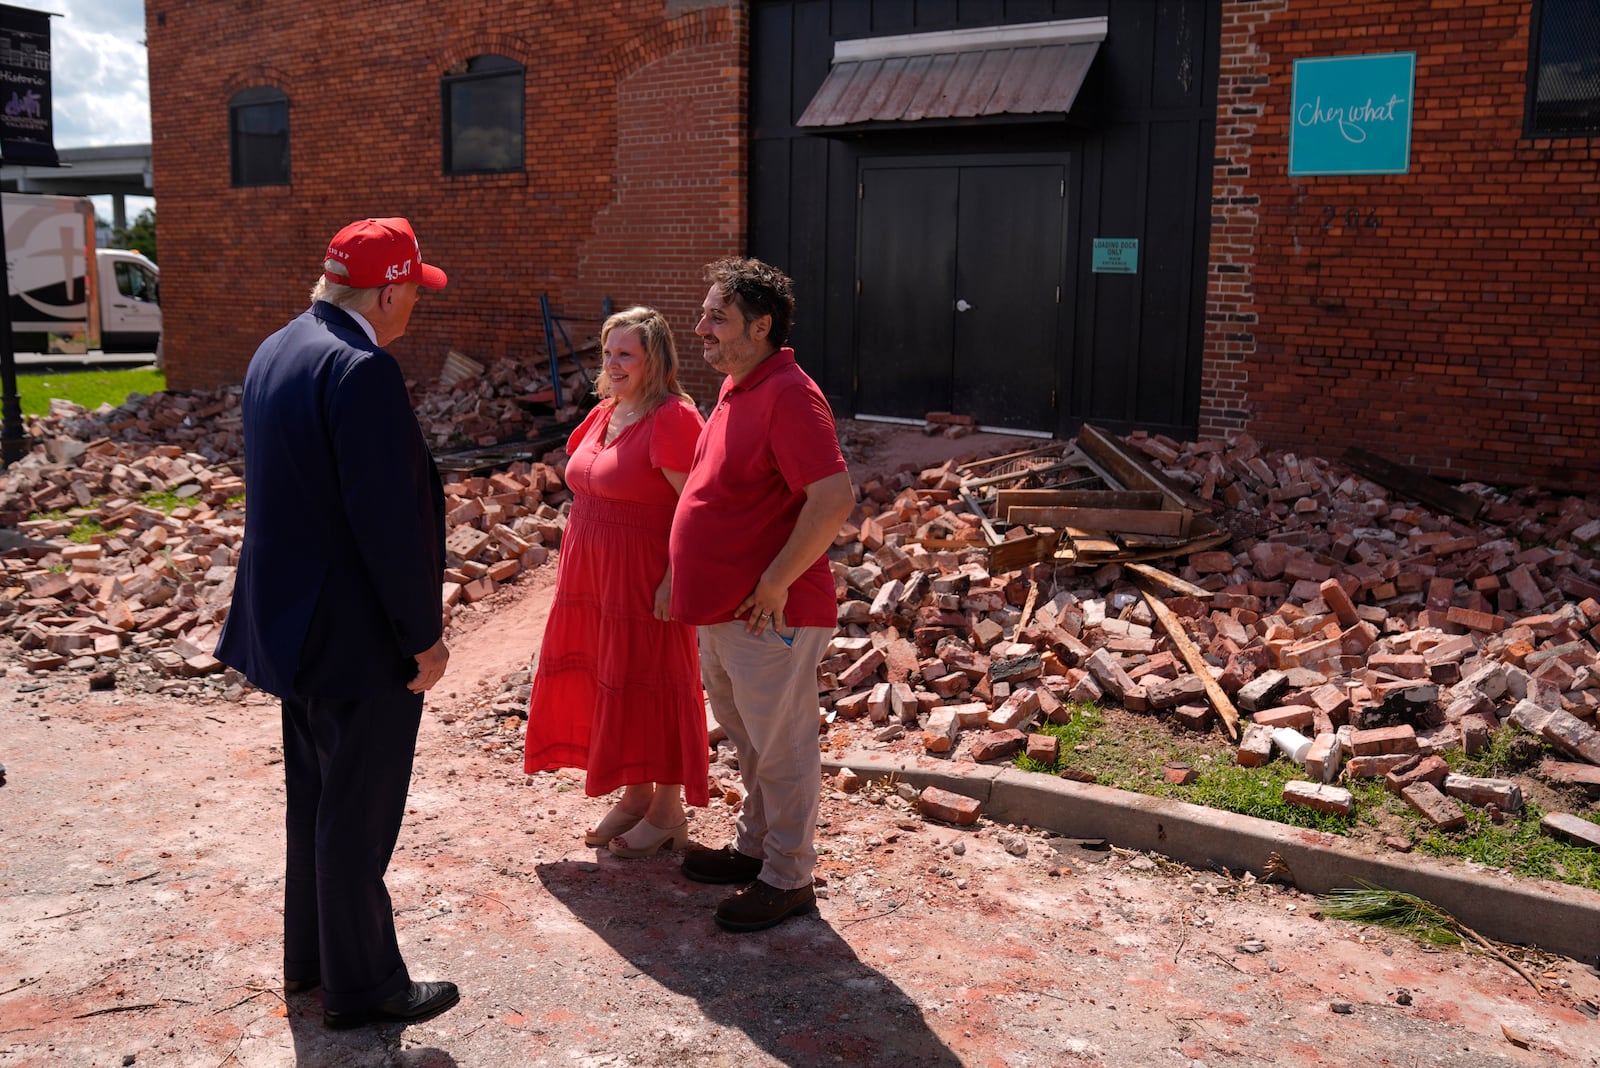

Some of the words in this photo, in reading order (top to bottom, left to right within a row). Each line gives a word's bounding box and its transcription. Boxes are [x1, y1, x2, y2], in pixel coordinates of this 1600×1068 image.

[0, 70, 46, 86] Historic
[1348, 94, 1406, 123] what
[1321, 205, 1380, 230] 204
[385, 259, 412, 281] 45-47
